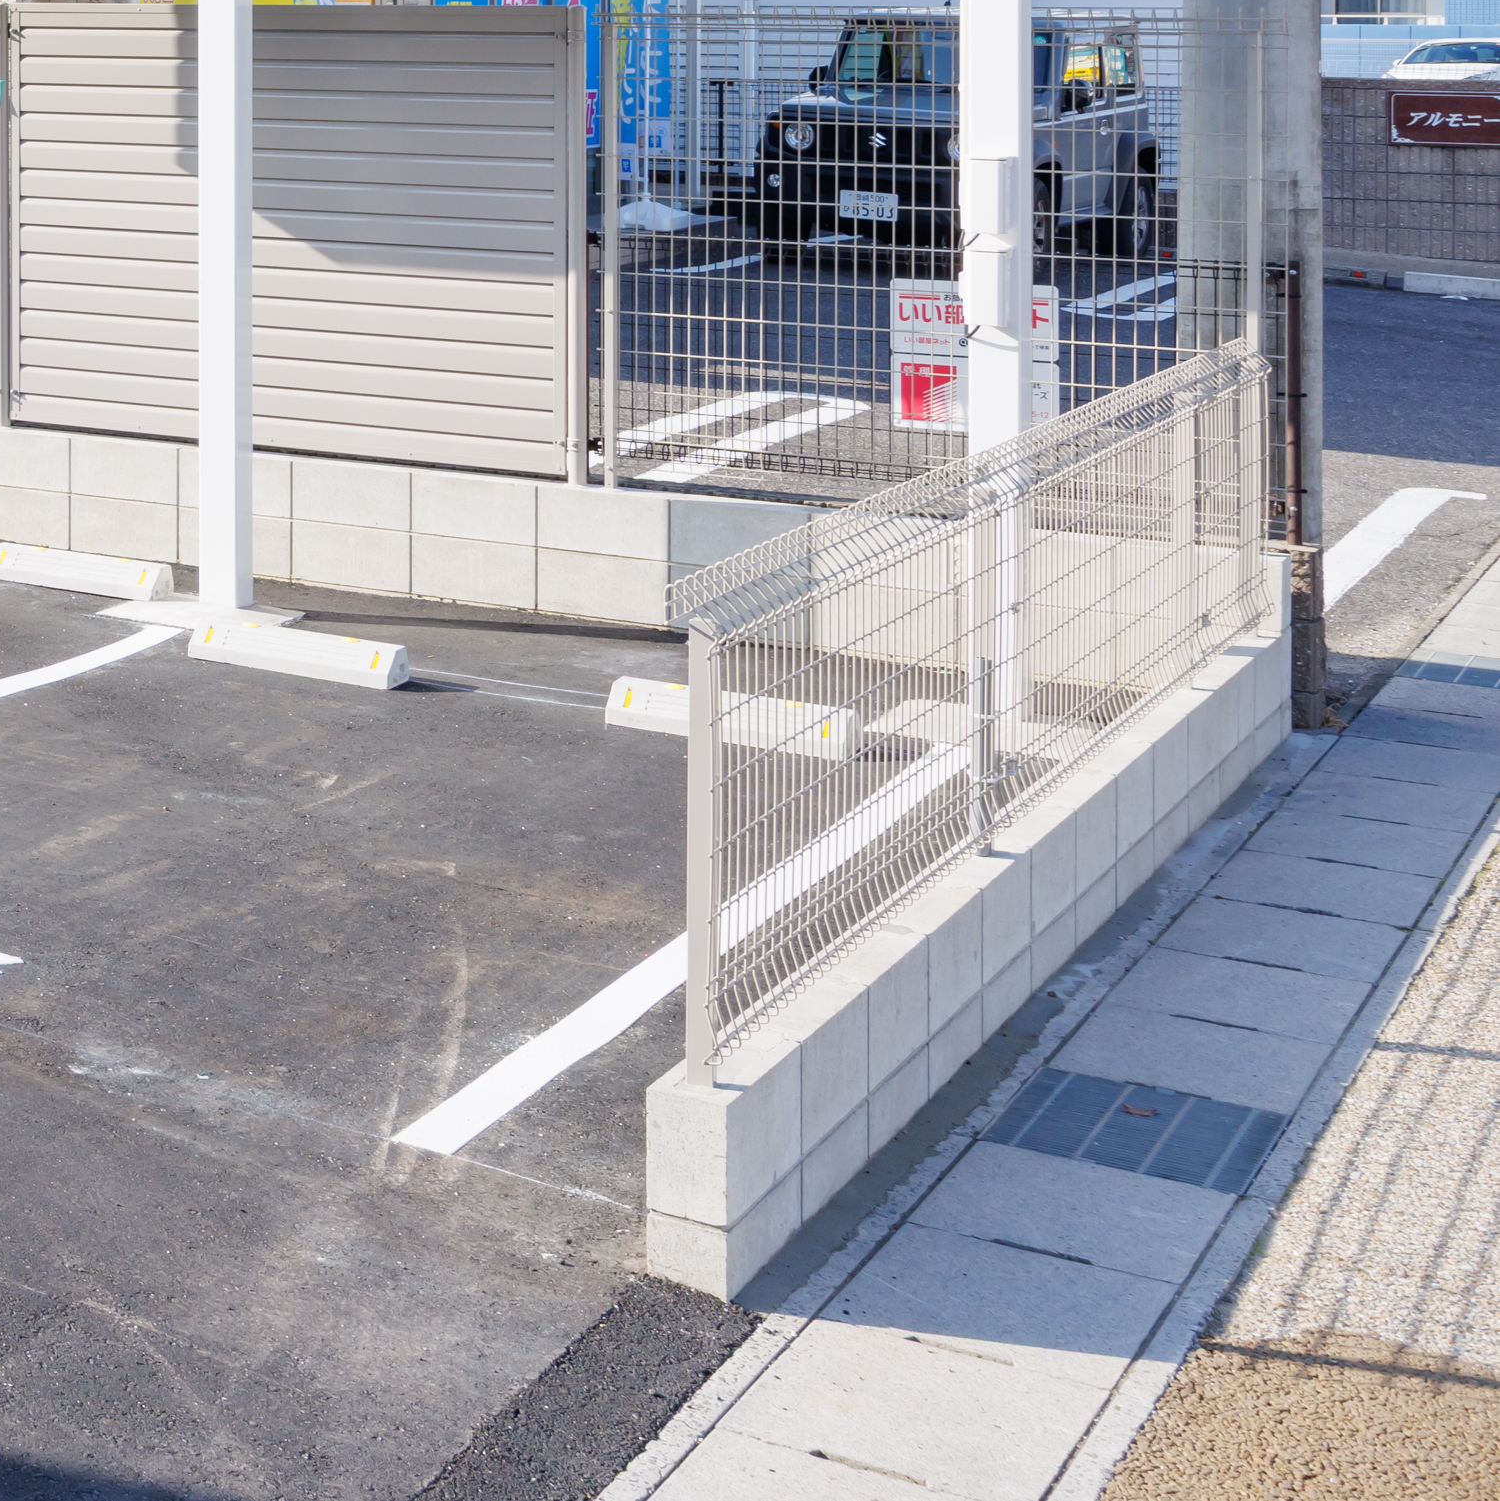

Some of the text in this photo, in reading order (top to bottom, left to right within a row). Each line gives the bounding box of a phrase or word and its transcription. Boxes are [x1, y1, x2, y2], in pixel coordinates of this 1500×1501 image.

[1405, 111, 1500, 128] アルモニー
